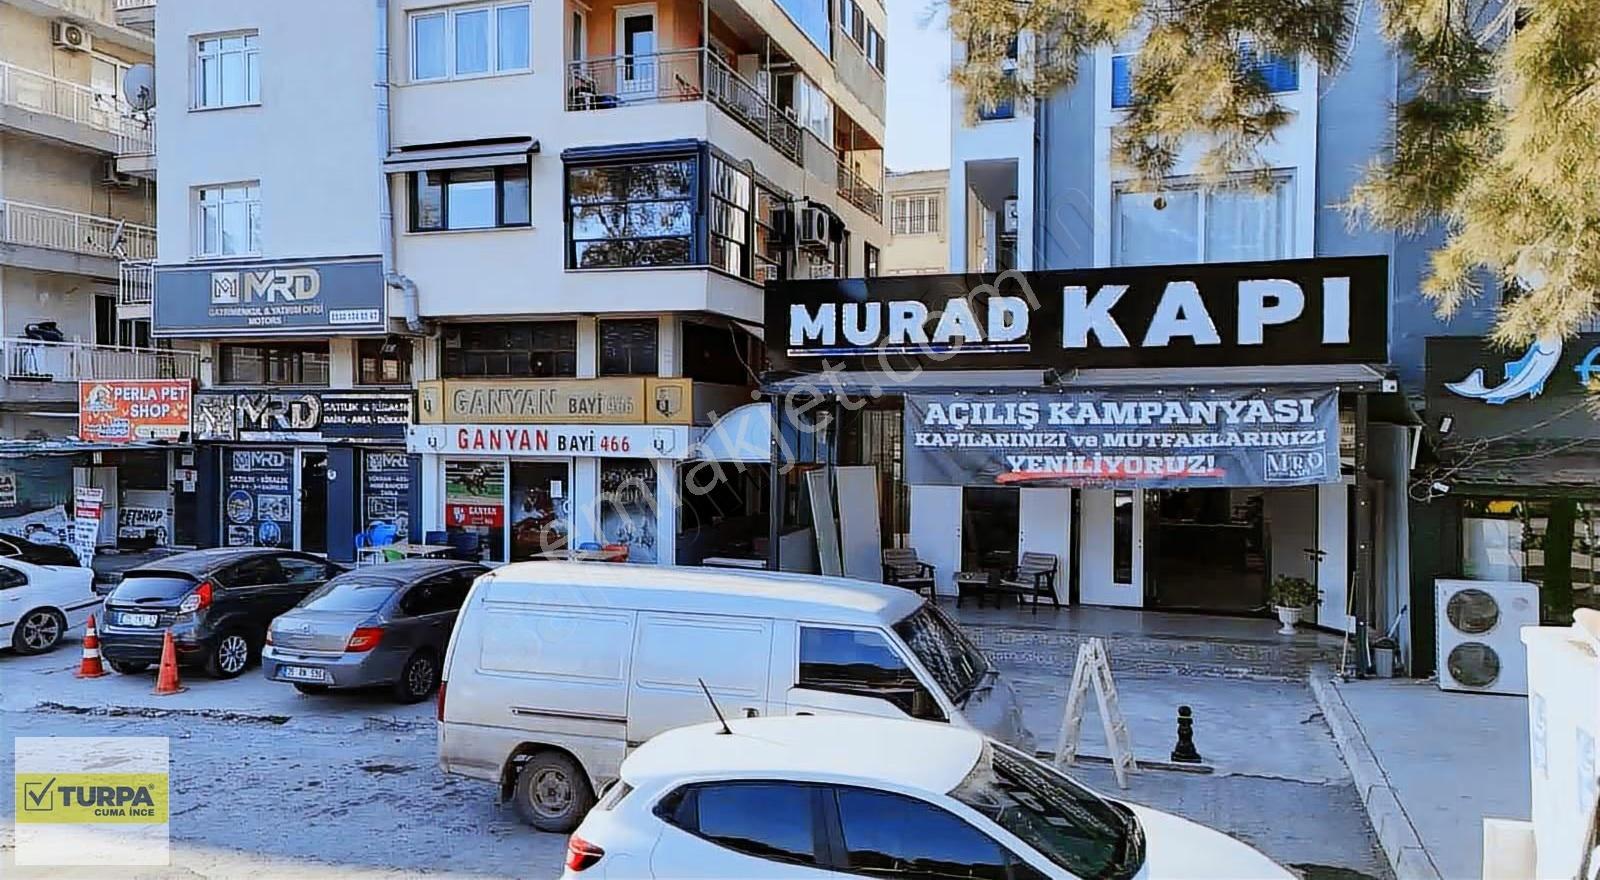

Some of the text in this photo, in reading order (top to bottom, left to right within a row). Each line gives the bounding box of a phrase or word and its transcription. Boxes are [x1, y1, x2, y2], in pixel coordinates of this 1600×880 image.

[244, 268, 321, 303] MRD
[790, 277, 1350, 348] MURAD KAPI
[113, 386, 188, 401] PERLA PET
[453, 389, 557, 415] GANYAN
[568, 394, 602, 414] BAYİ
[130, 404, 171, 418] SHOP
[236, 393, 322, 429] MRD
[924, 399, 1315, 430] AÇILIŞ KAMPANYASI
[458, 428, 630, 452] GANYAN BAYİ 466
[915, 430, 1327, 448] KAPILARINIZI ve MUTFAKLARINIZI
[251, 451, 285, 467] MRD
[1006, 451, 1216, 475] YENİLİYORUZ!
